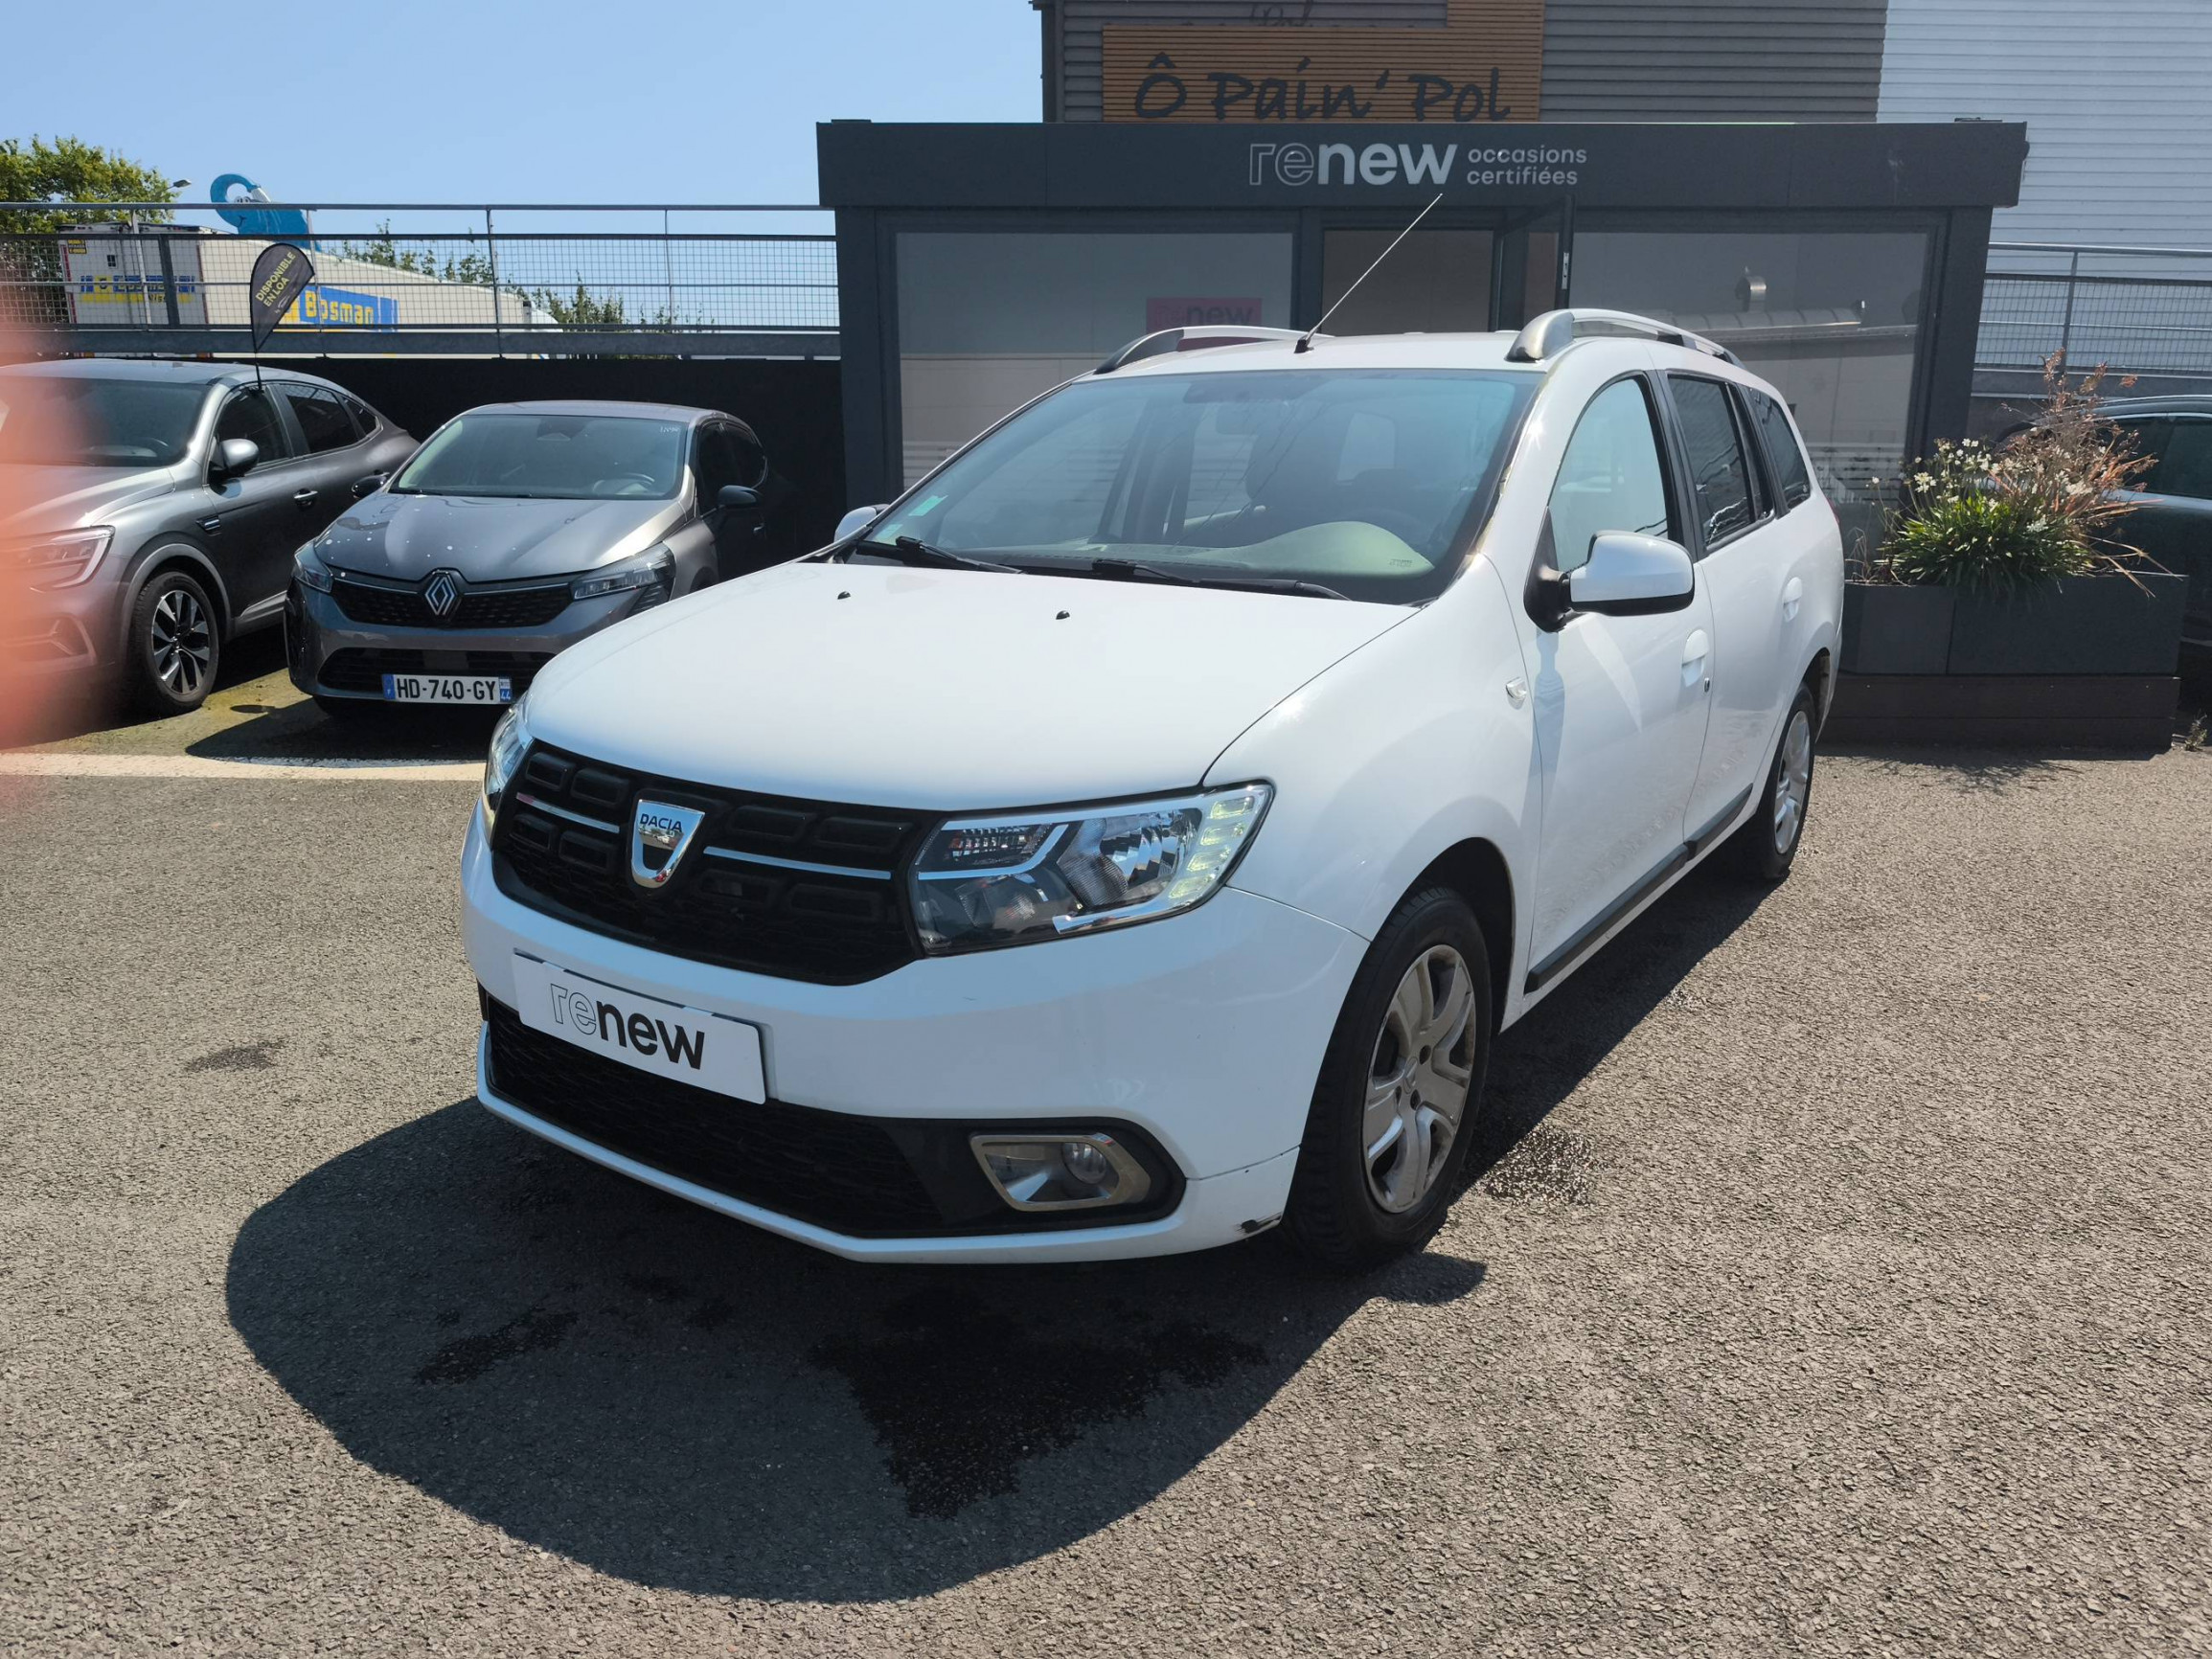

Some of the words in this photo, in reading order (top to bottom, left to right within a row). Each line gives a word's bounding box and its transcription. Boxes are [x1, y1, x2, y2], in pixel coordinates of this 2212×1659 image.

[1134, 52, 1187, 118] Ô
[1407, 66, 1511, 122] Pol
[1249, 143, 1458, 186] renew
[1468, 145, 1587, 164] occasions
[1467, 165, 1578, 186] certifiées
[256, 252, 296, 302] DISPONIBLE
[263, 294, 276, 307] EN
[274, 277, 289, 295] LOA
[305, 289, 375, 326] Bosman
[397, 678, 496, 700] HD-740-GY
[640, 813, 683, 832] DACIA
[550, 983, 705, 1070] renew
